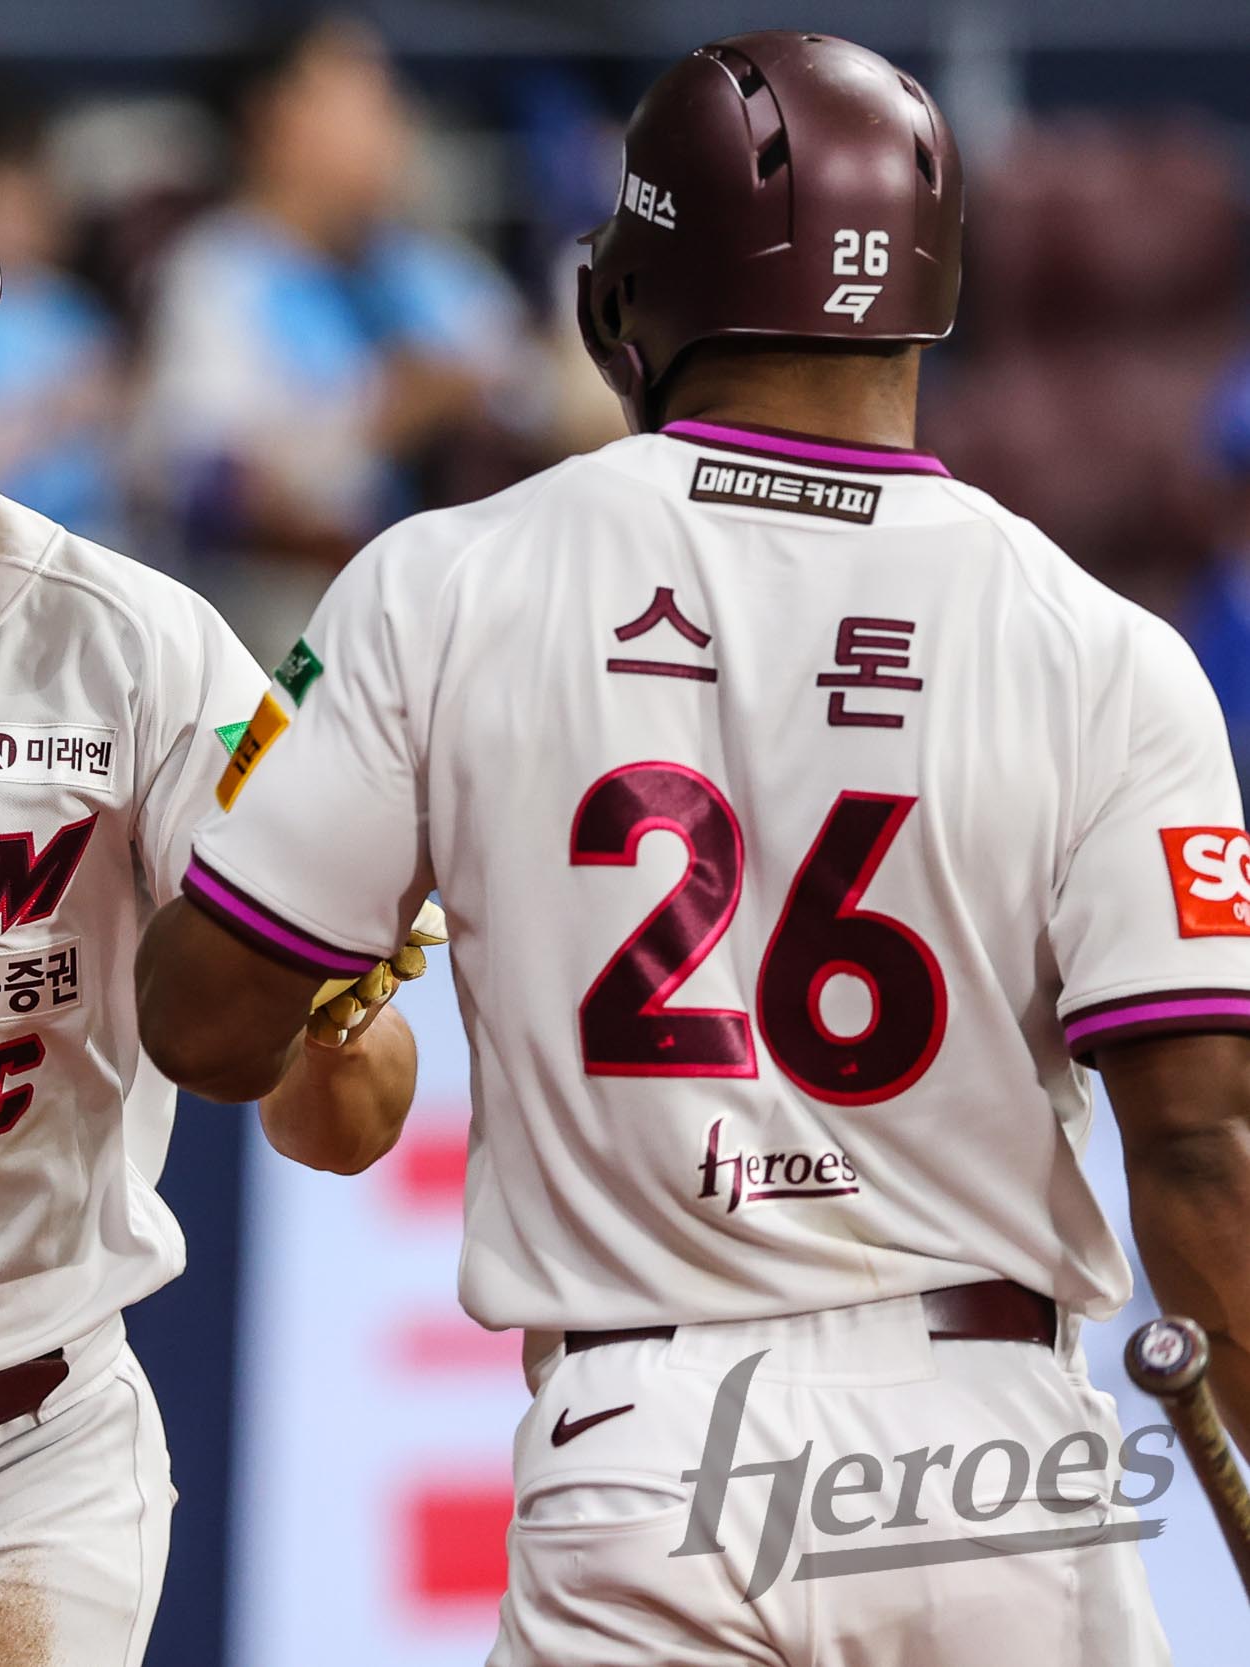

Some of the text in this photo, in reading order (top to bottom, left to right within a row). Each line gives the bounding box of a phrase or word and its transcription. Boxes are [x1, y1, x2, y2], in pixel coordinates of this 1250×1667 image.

[833, 229, 890, 277] 26
[695, 464, 874, 515] 매머드커피
[606, 586, 924, 730] 스톤
[26, 736, 113, 776] 미래엔
[569, 759, 949, 1108] 26
